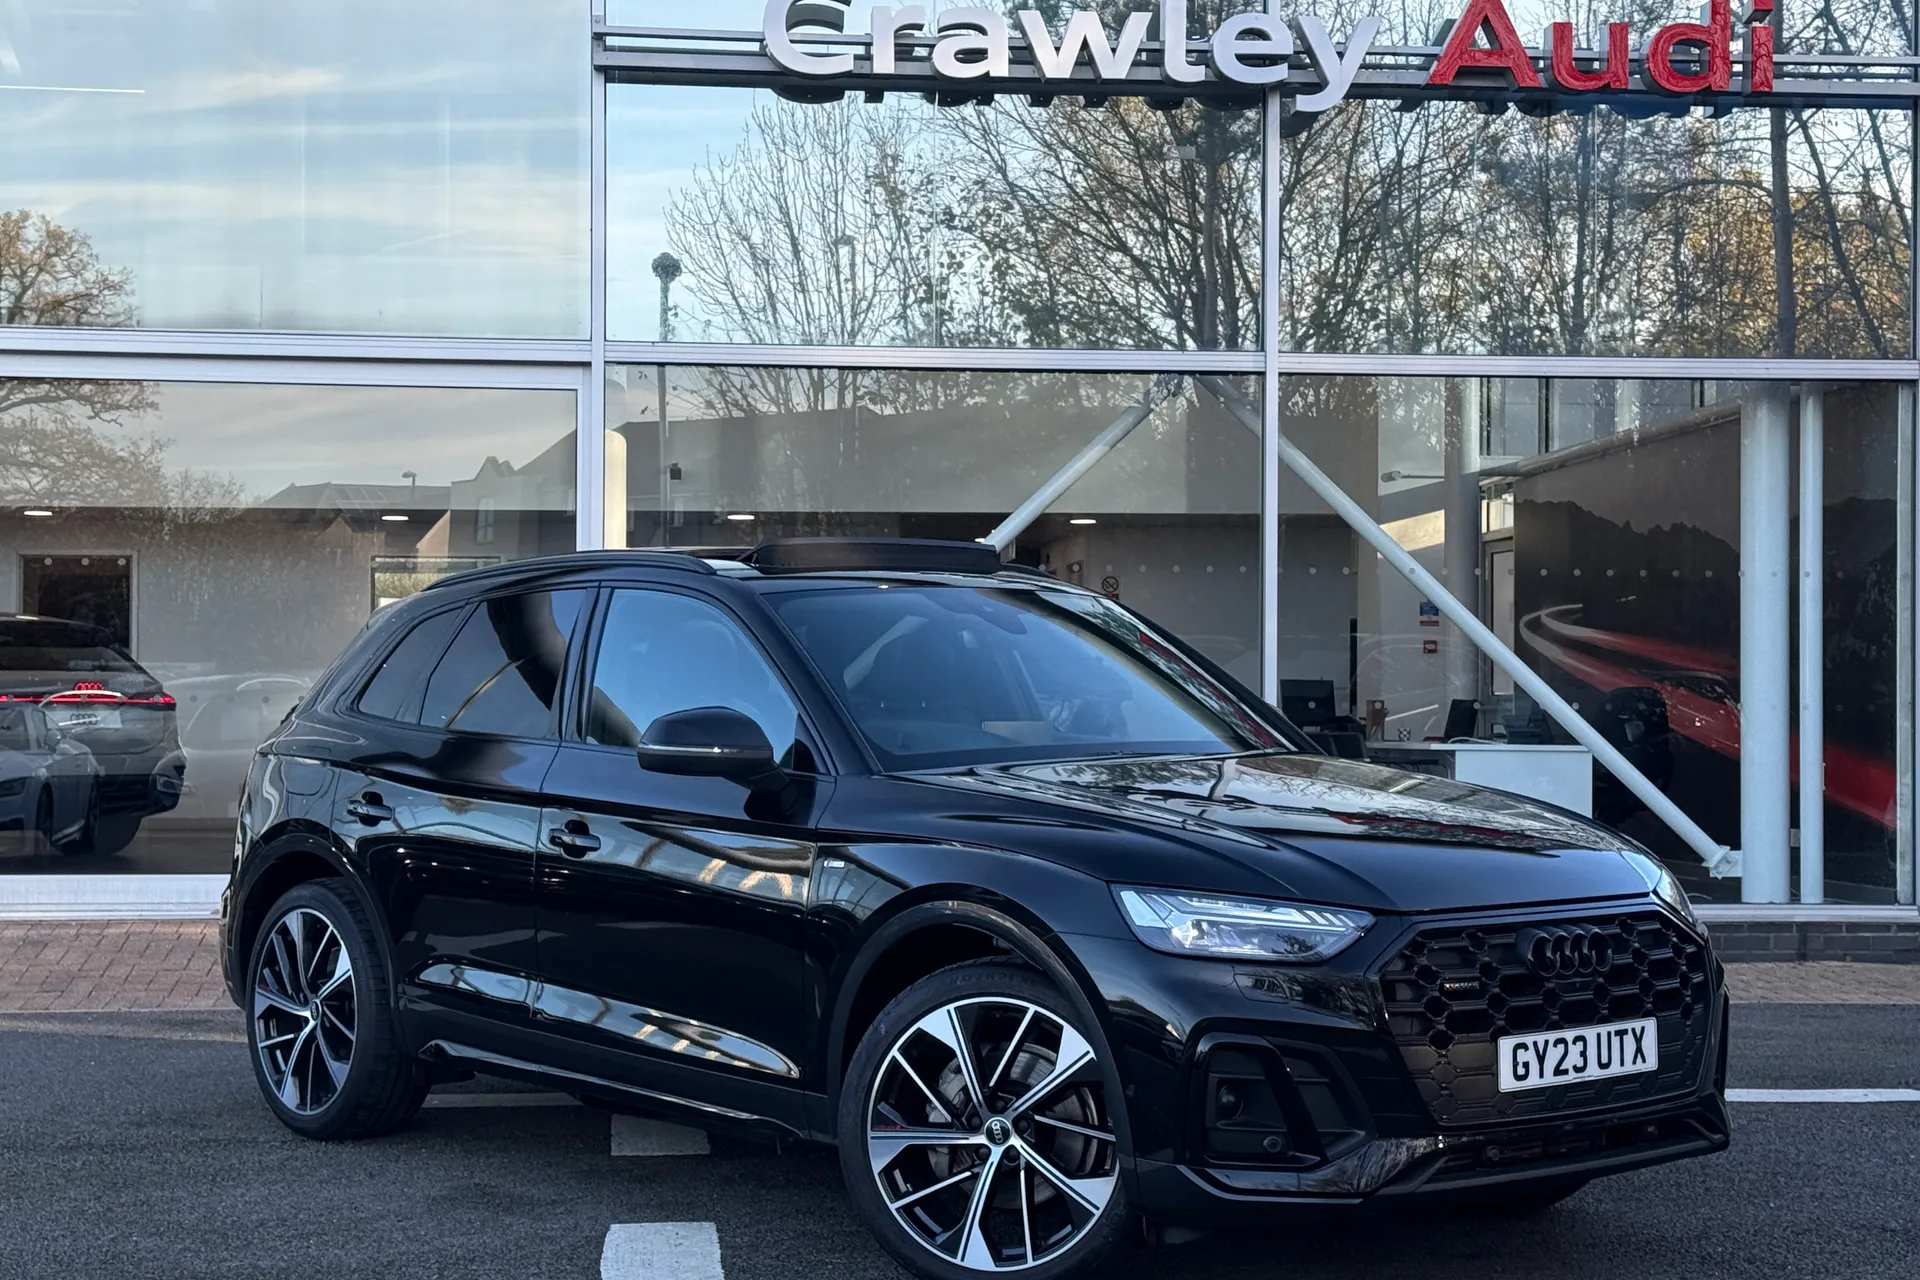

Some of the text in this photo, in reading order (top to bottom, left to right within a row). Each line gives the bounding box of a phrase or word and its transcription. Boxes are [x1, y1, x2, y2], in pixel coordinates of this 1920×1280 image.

[763, 0, 1774, 112] Crawley Audi
[1512, 1026, 1647, 1082] GY23 UTX
